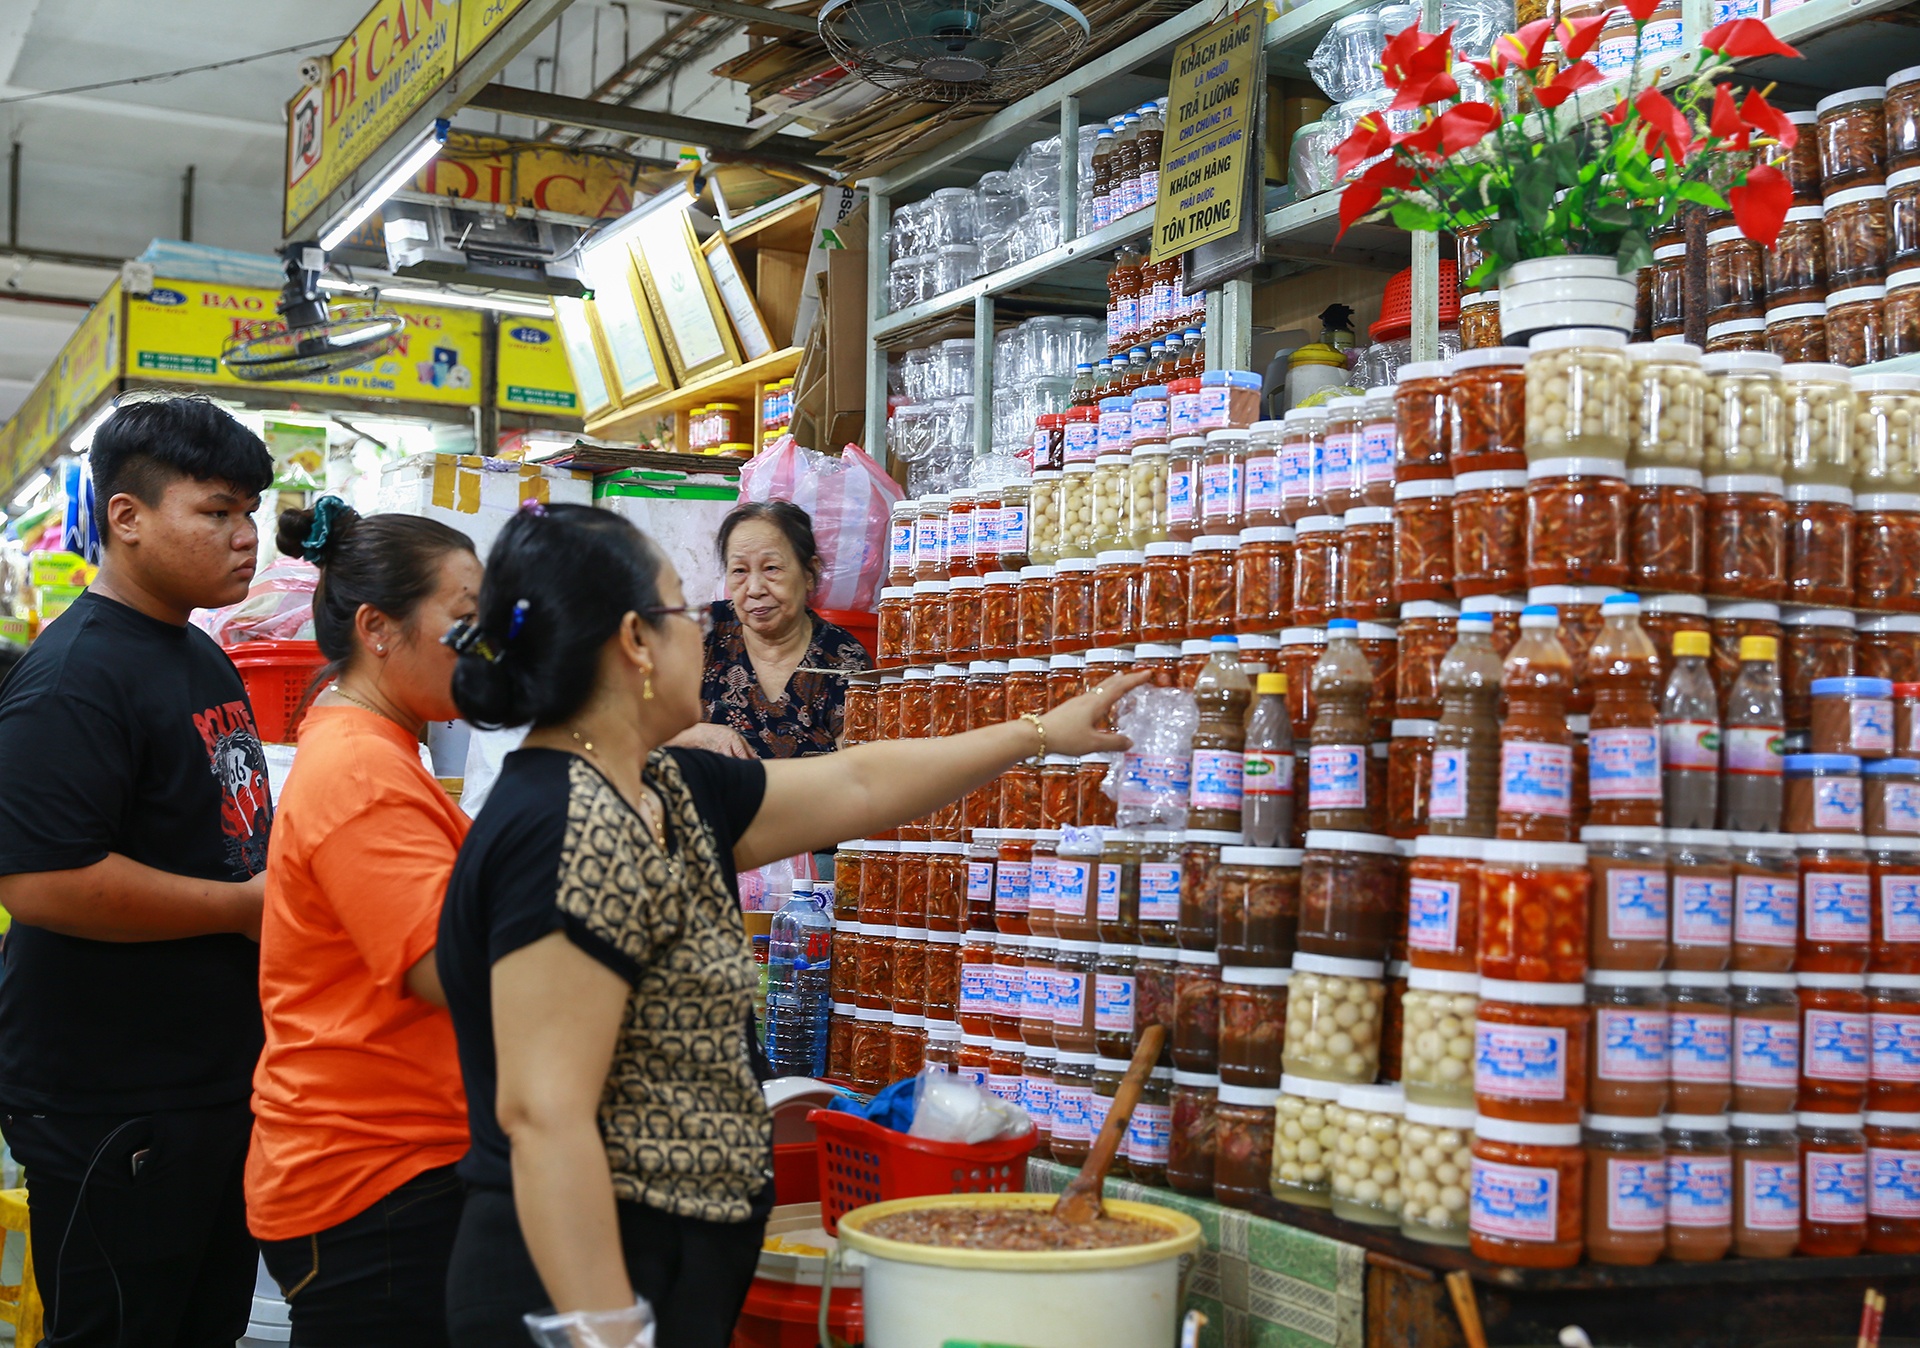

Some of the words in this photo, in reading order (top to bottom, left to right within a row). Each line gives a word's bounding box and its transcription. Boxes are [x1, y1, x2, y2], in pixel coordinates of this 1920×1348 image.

[1179, 40, 1217, 77] KHÁCH
[1220, 24, 1251, 57] HÀNG
[329, 32, 360, 128] DÌ
[1194, 70, 1204, 88] LÀ
[1205, 59, 1229, 84] NGƯỜI
[1179, 92, 1200, 123] TRẢ
[1202, 78, 1240, 112] LƯƠNG
[1179, 124, 1194, 142] CHO
[1195, 112, 1221, 136] CHÚNG
[1223, 106, 1233, 120] TA
[1166, 156, 1187, 174] TRONG
[1187, 148, 1200, 168] MỌI
[1201, 140, 1217, 160] TÌNH
[1218, 129, 1242, 151] HUỐNG
[1169, 168, 1202, 196] KHÁCH
[1204, 155, 1231, 182] HÀNG
[1162, 213, 1185, 245] TÔN
[1189, 199, 1231, 232] TRỌNG
[1180, 192, 1195, 211] PHẢI
[202, 292, 263, 312] BAO
